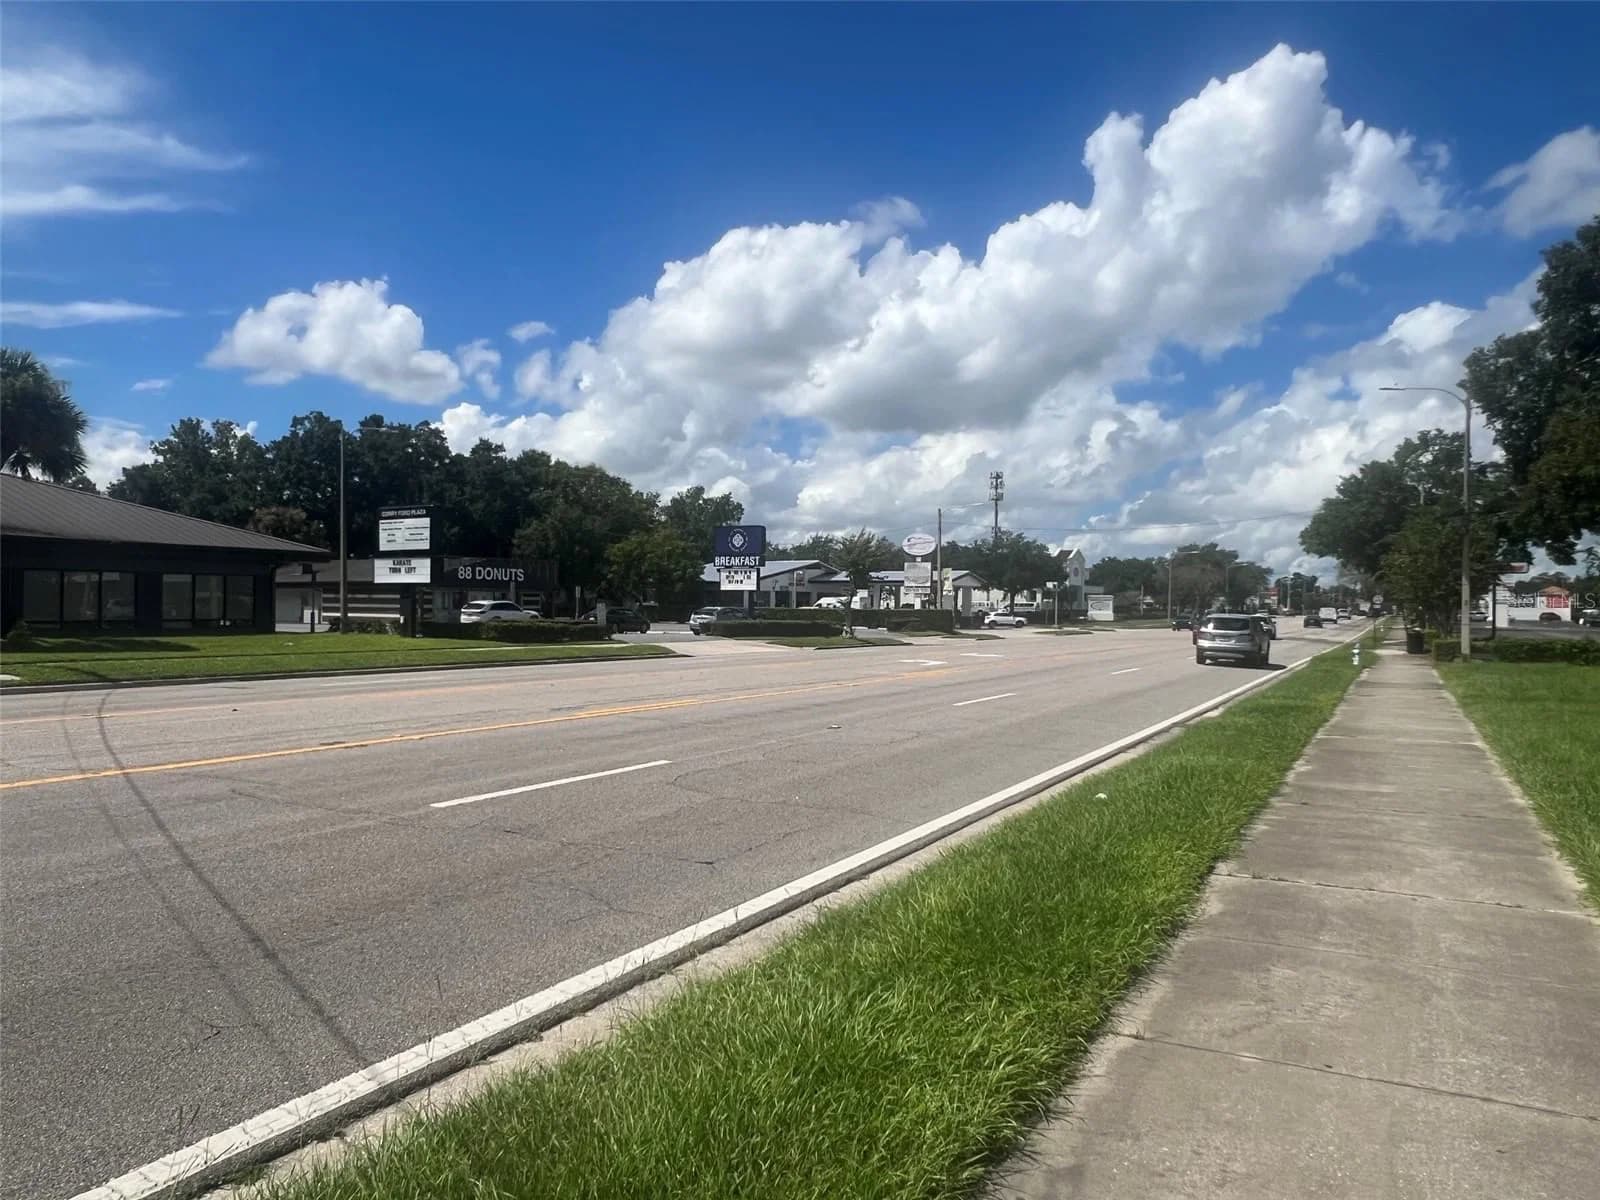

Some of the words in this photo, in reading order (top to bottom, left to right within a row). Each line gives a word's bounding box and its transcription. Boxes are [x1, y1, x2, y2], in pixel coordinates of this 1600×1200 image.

[715, 556, 760, 566] BREAKFAST
[457, 566, 472, 579] 88
[475, 566, 525, 581] DONUTS
